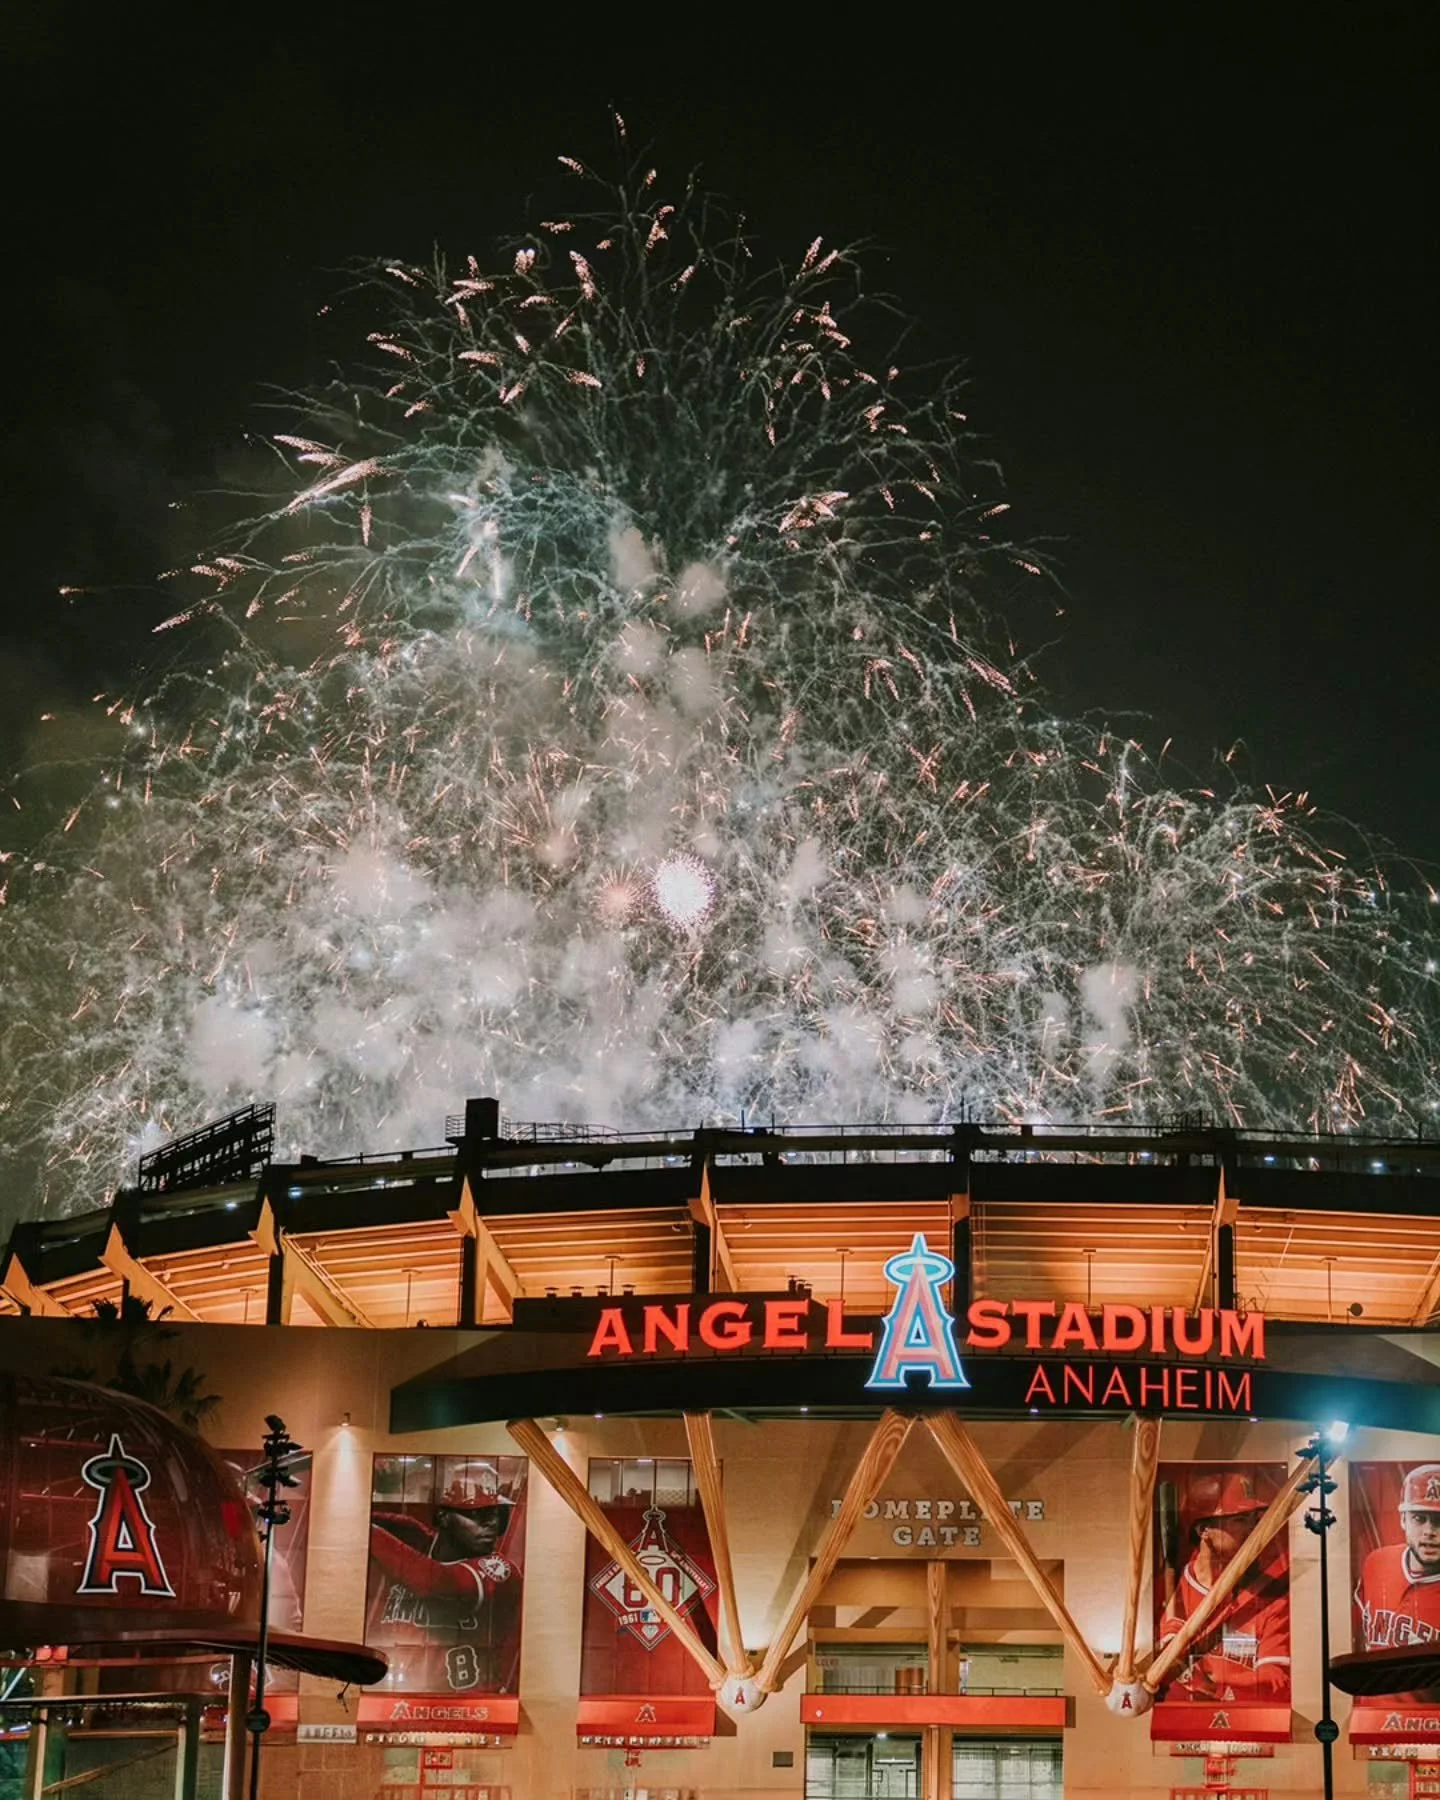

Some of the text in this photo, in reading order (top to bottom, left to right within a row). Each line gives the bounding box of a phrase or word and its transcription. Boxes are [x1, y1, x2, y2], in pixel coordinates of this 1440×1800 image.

[586, 1231, 1266, 1389] ANGEL A STADIUM
[1024, 1362, 1253, 1412] ANAHEIM
[76, 1432, 177, 1598] A
[831, 1499, 1044, 1520] OMEPLTE
[892, 1525, 981, 1546] GATE
[618, 1613, 638, 1626] 1961
[445, 1645, 480, 1690] 8
[735, 1686, 745, 1705] A
[1121, 1691, 1132, 1709] A
[390, 1700, 488, 1721] ANGELS
[635, 1703, 657, 1723] A
[1209, 1710, 1231, 1729] A
